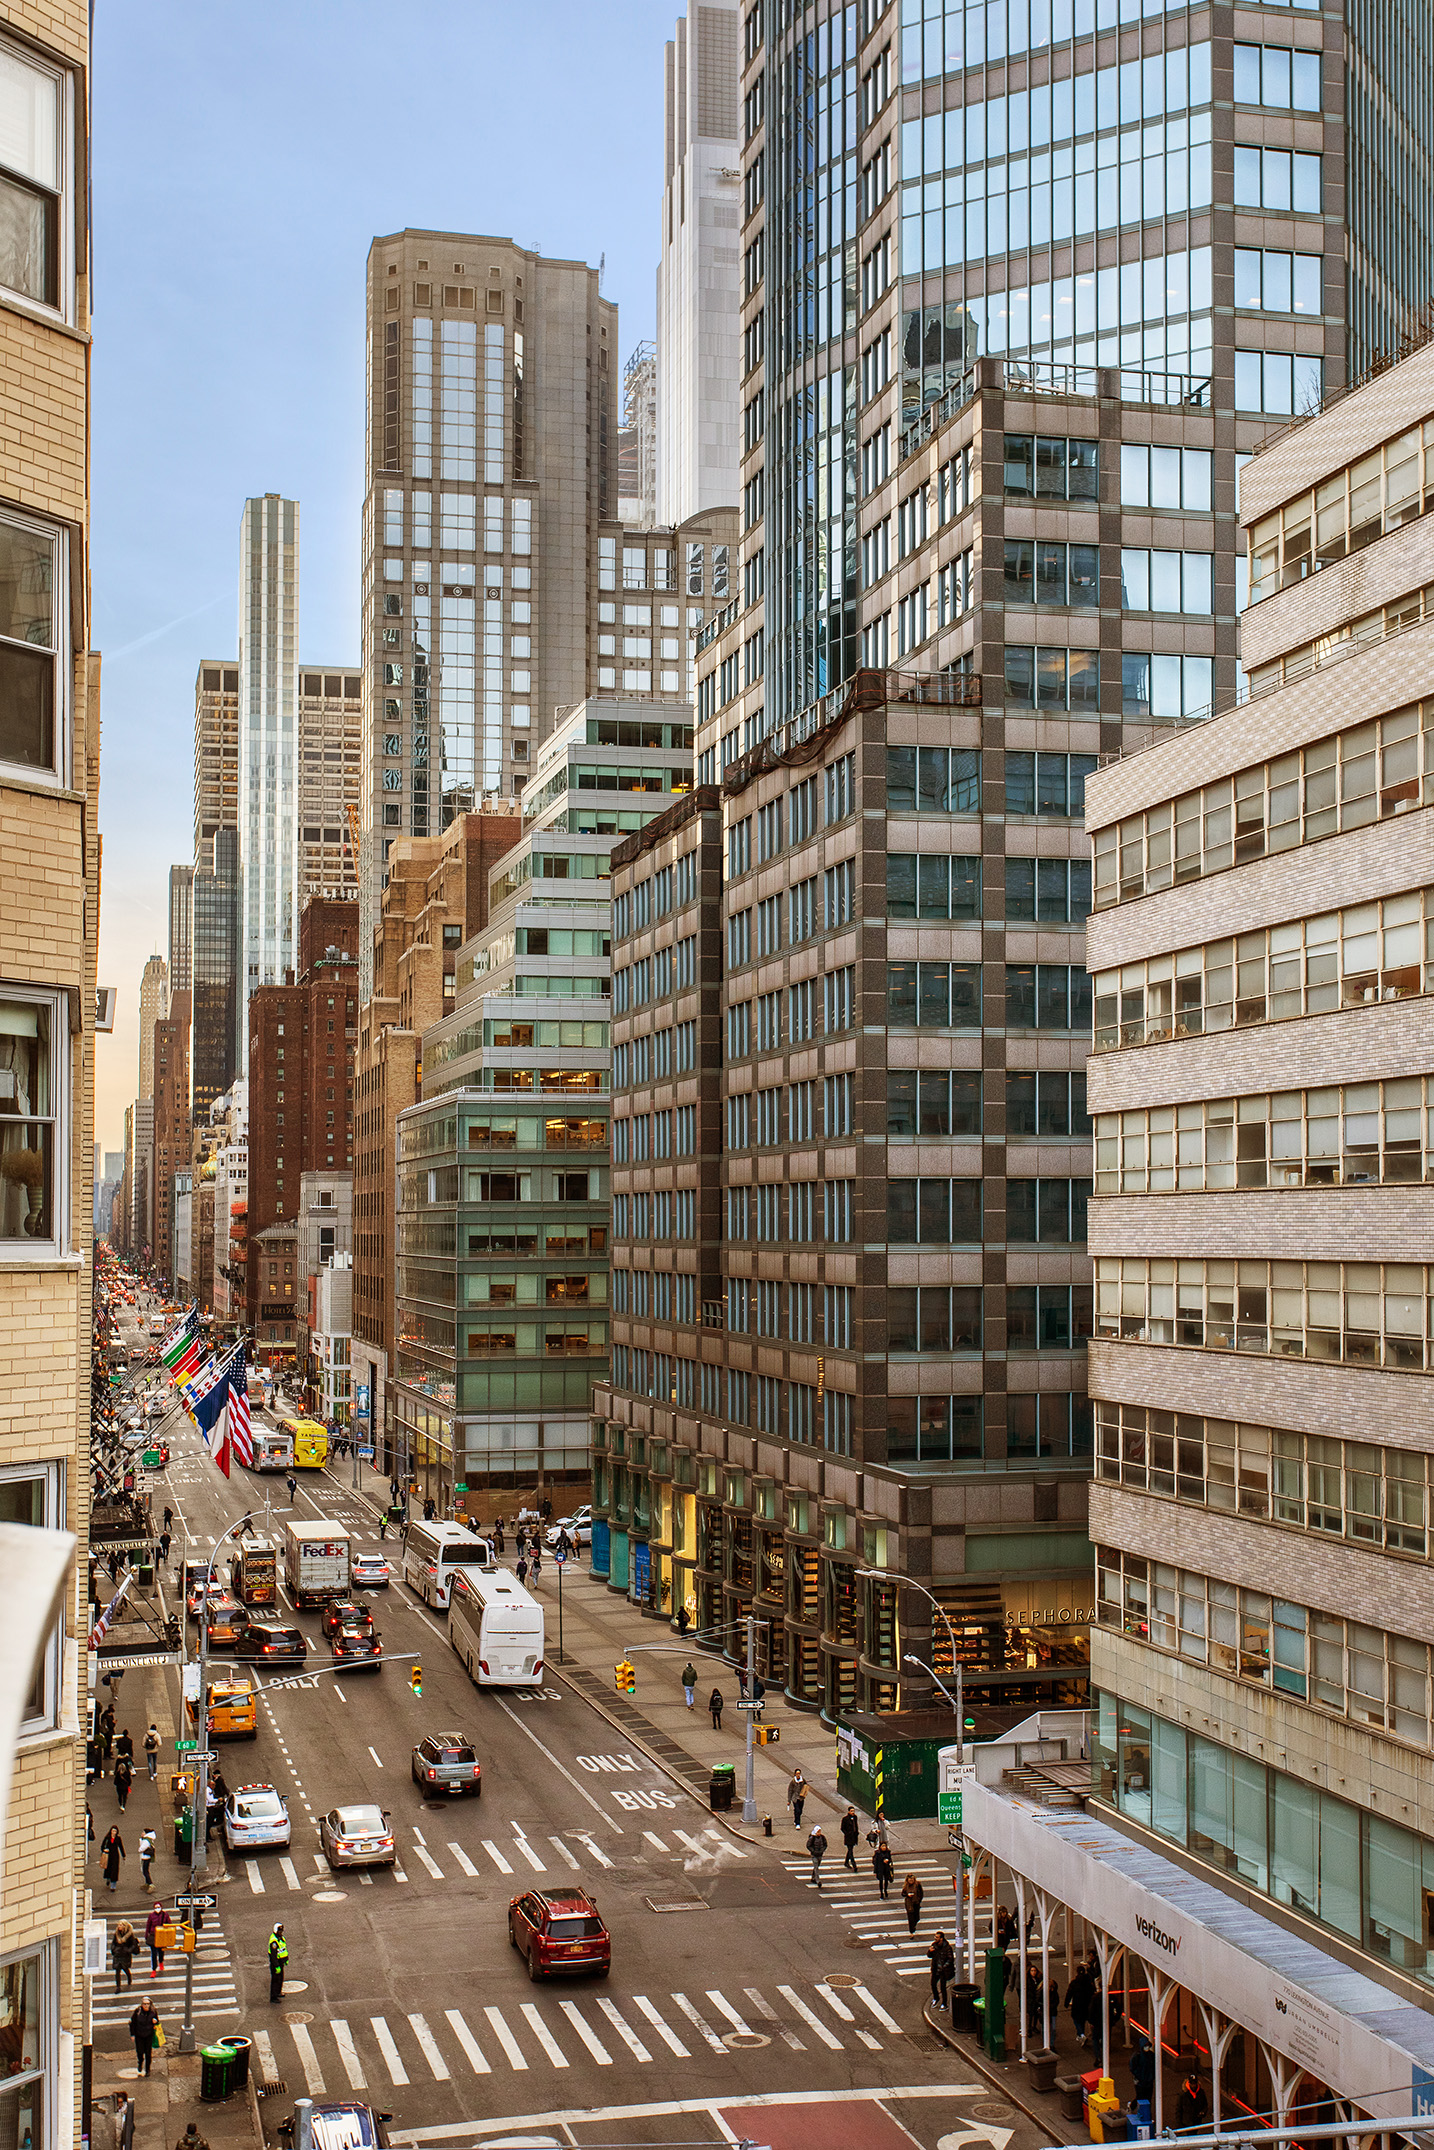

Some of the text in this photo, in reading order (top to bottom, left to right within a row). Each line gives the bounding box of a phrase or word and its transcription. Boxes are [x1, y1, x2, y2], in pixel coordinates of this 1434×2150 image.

[303, 1544, 344, 1557] FedEx
[248, 1608, 282, 1620] NLY
[1005, 1606, 1096, 1625] SEPHORA
[269, 1675, 320, 1690] ONLY
[513, 1687, 562, 1701] BUS
[182, 1742, 190, 1750] 60
[576, 1754, 642, 1773] ONLY
[947, 1766, 975, 1775] RIGHT LANE
[610, 1790, 676, 1811] BUS
[1135, 1913, 1177, 1956] verizon
